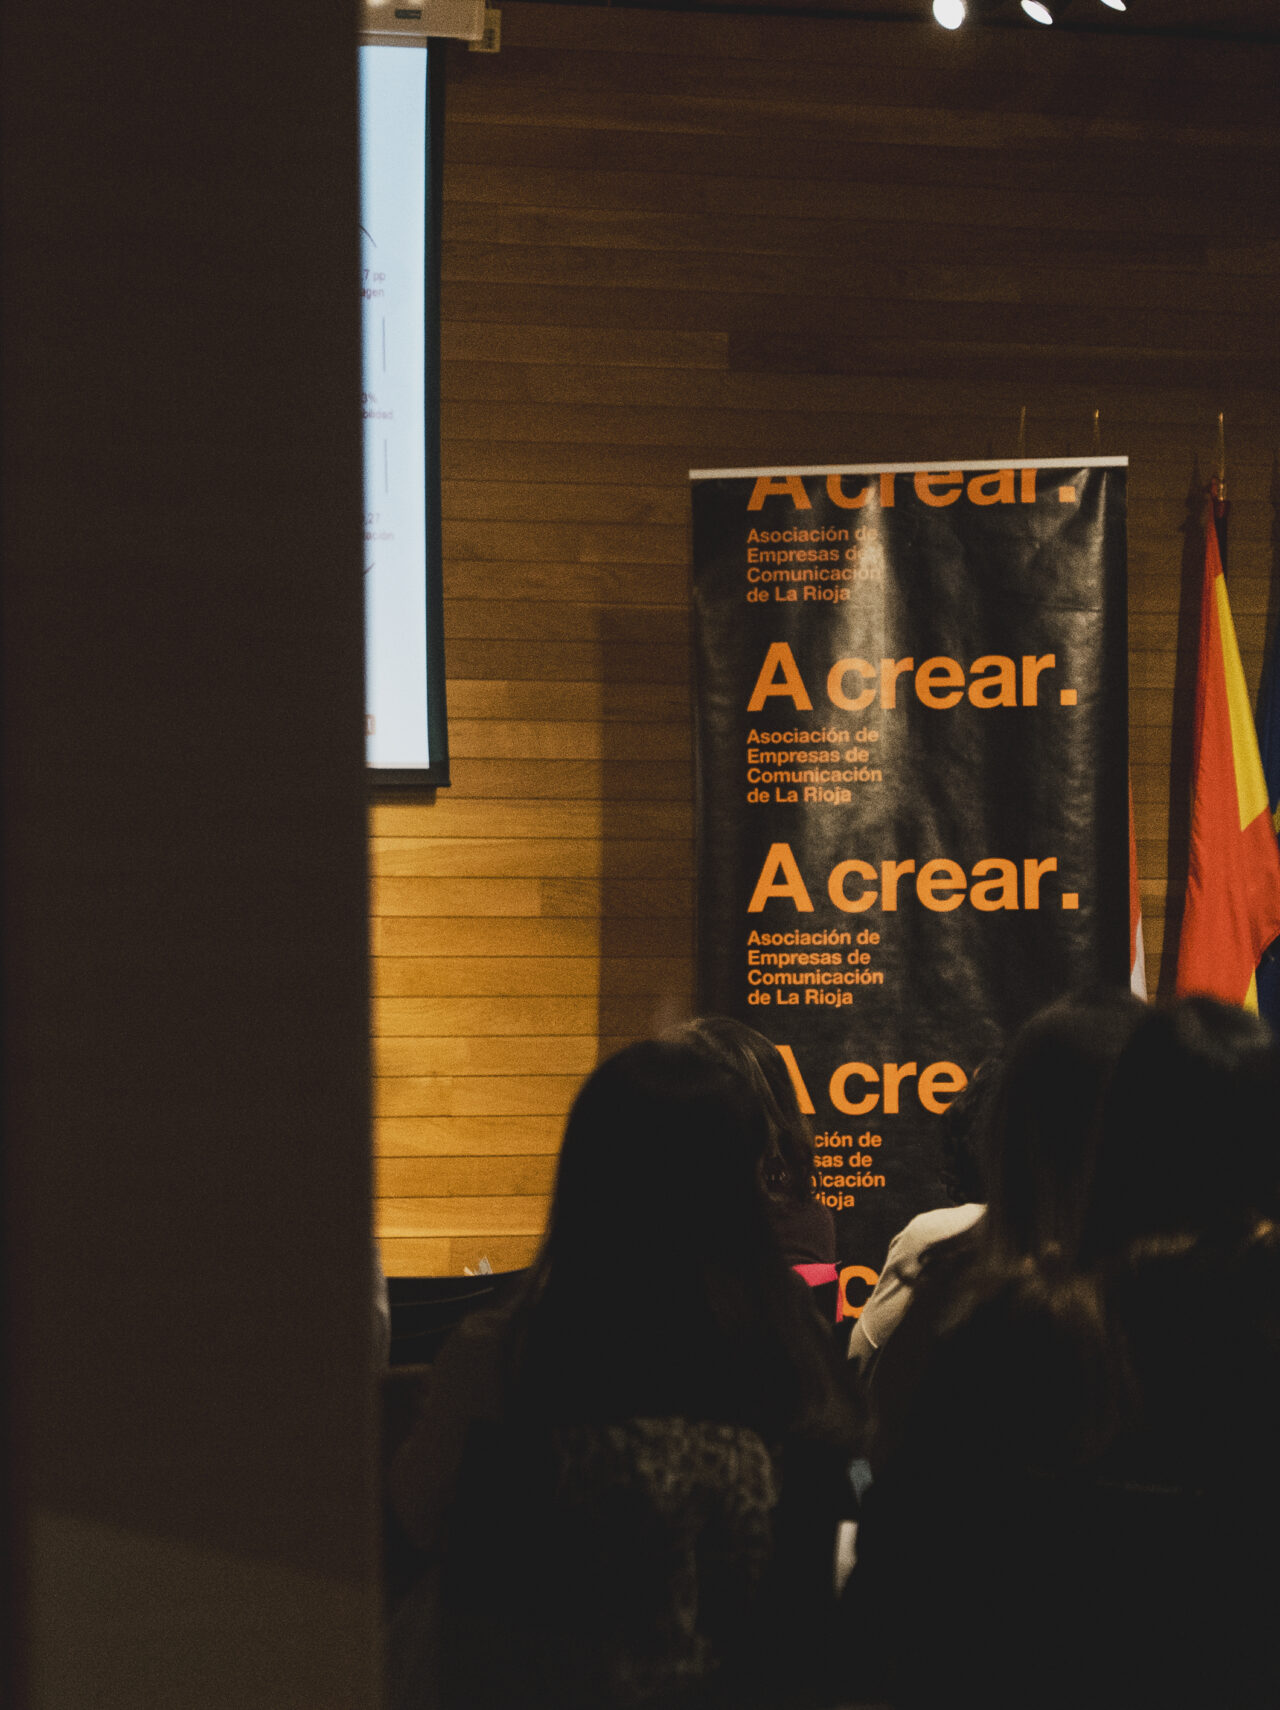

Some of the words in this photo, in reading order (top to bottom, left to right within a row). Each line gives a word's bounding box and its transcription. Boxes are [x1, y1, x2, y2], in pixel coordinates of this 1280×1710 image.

[747, 526, 849, 544] Asociación
[854, 524, 878, 541] de
[747, 547, 840, 565] Empresas
[746, 587, 770, 603] de
[775, 586, 798, 602] La
[803, 585, 851, 604] Rioja
[747, 642, 813, 712] A
[827, 654, 1078, 713] crear.
[747, 726, 851, 746] Asociación
[854, 727, 880, 744] de
[748, 748, 841, 766] Empresas
[843, 746, 870, 763] de
[747, 763, 882, 784] Comunicación
[747, 788, 770, 803] de
[776, 787, 798, 802] La
[803, 782, 852, 806] Rioja
[748, 843, 814, 912] A
[828, 857, 1079, 913] crear.
[747, 928, 851, 946] Asociación
[856, 929, 880, 945] de
[748, 949, 842, 968] Empresas
[847, 949, 871, 965] de
[748, 966, 884, 985] Comunicación
[748, 990, 771, 1005] de
[777, 989, 799, 1005] La
[805, 988, 853, 1008] Rioja
[829, 1061, 968, 1115] cre
[858, 1132, 882, 1147] de
[849, 1152, 872, 1167] de
[816, 1192, 855, 1211] ioja
